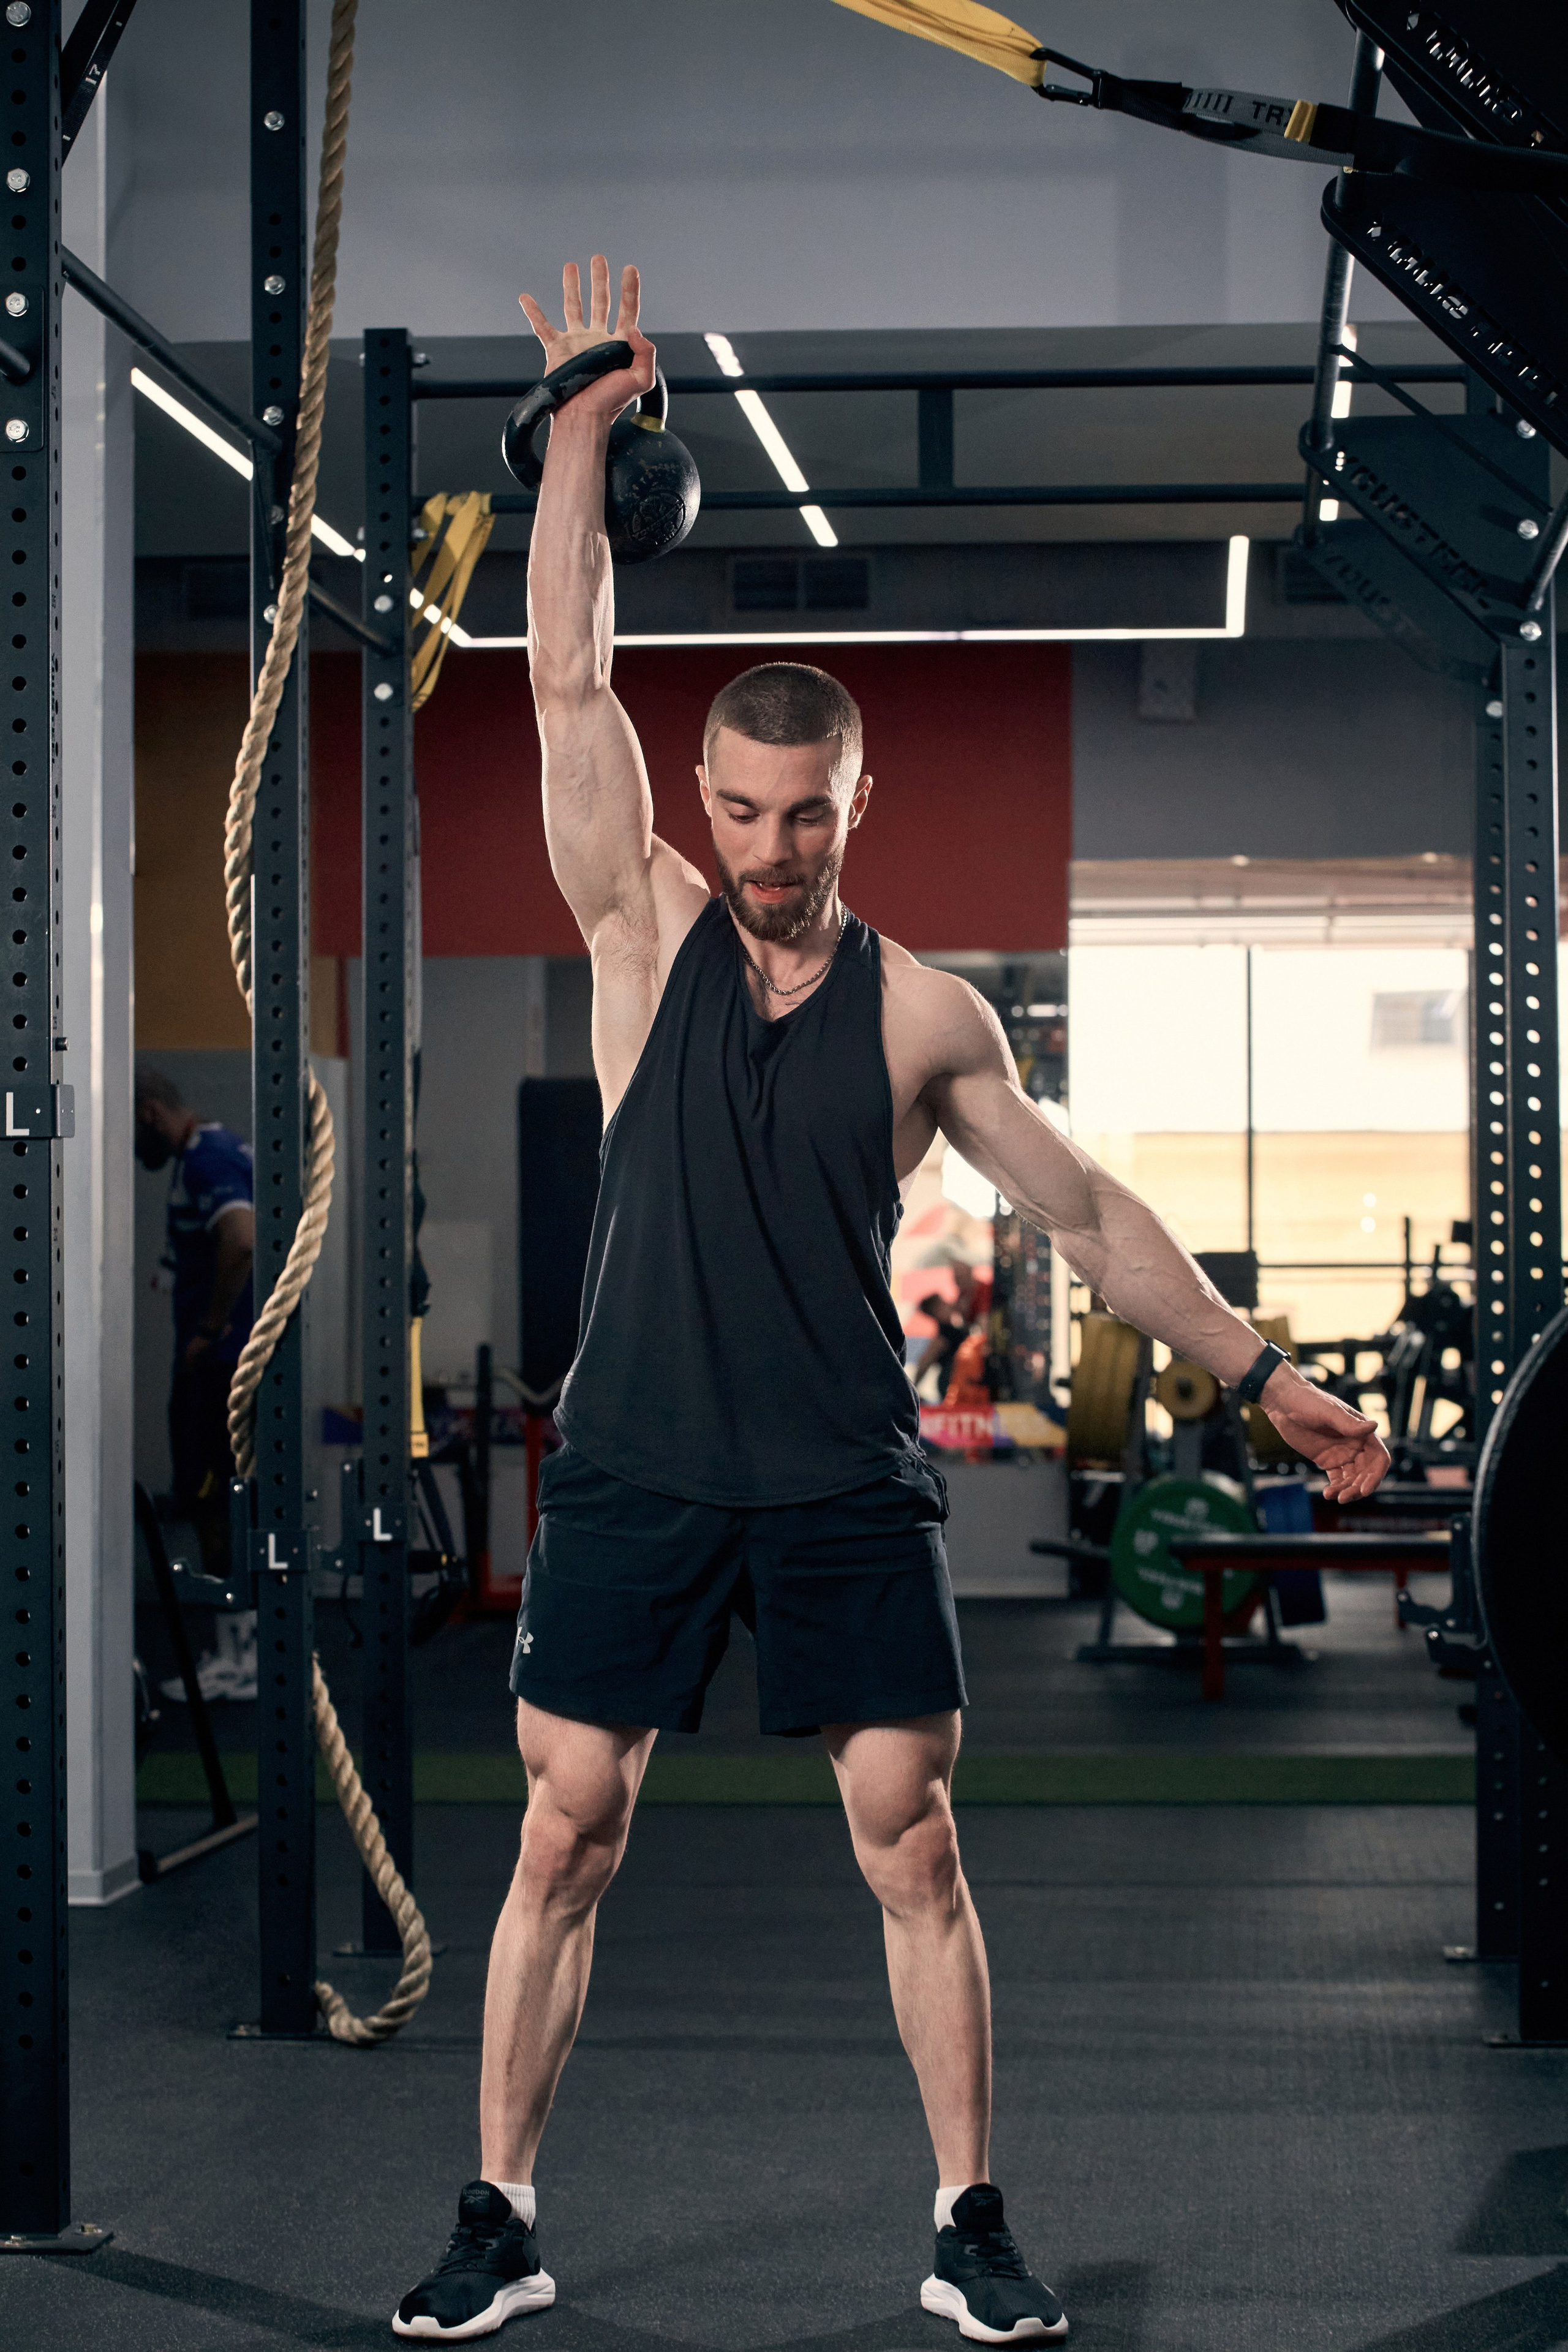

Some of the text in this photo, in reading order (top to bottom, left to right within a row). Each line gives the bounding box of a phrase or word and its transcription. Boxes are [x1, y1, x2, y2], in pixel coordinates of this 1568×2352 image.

[6, 1092, 29, 1136] L
[374, 1507, 392, 1540] L
[268, 1533, 288, 1568] L
